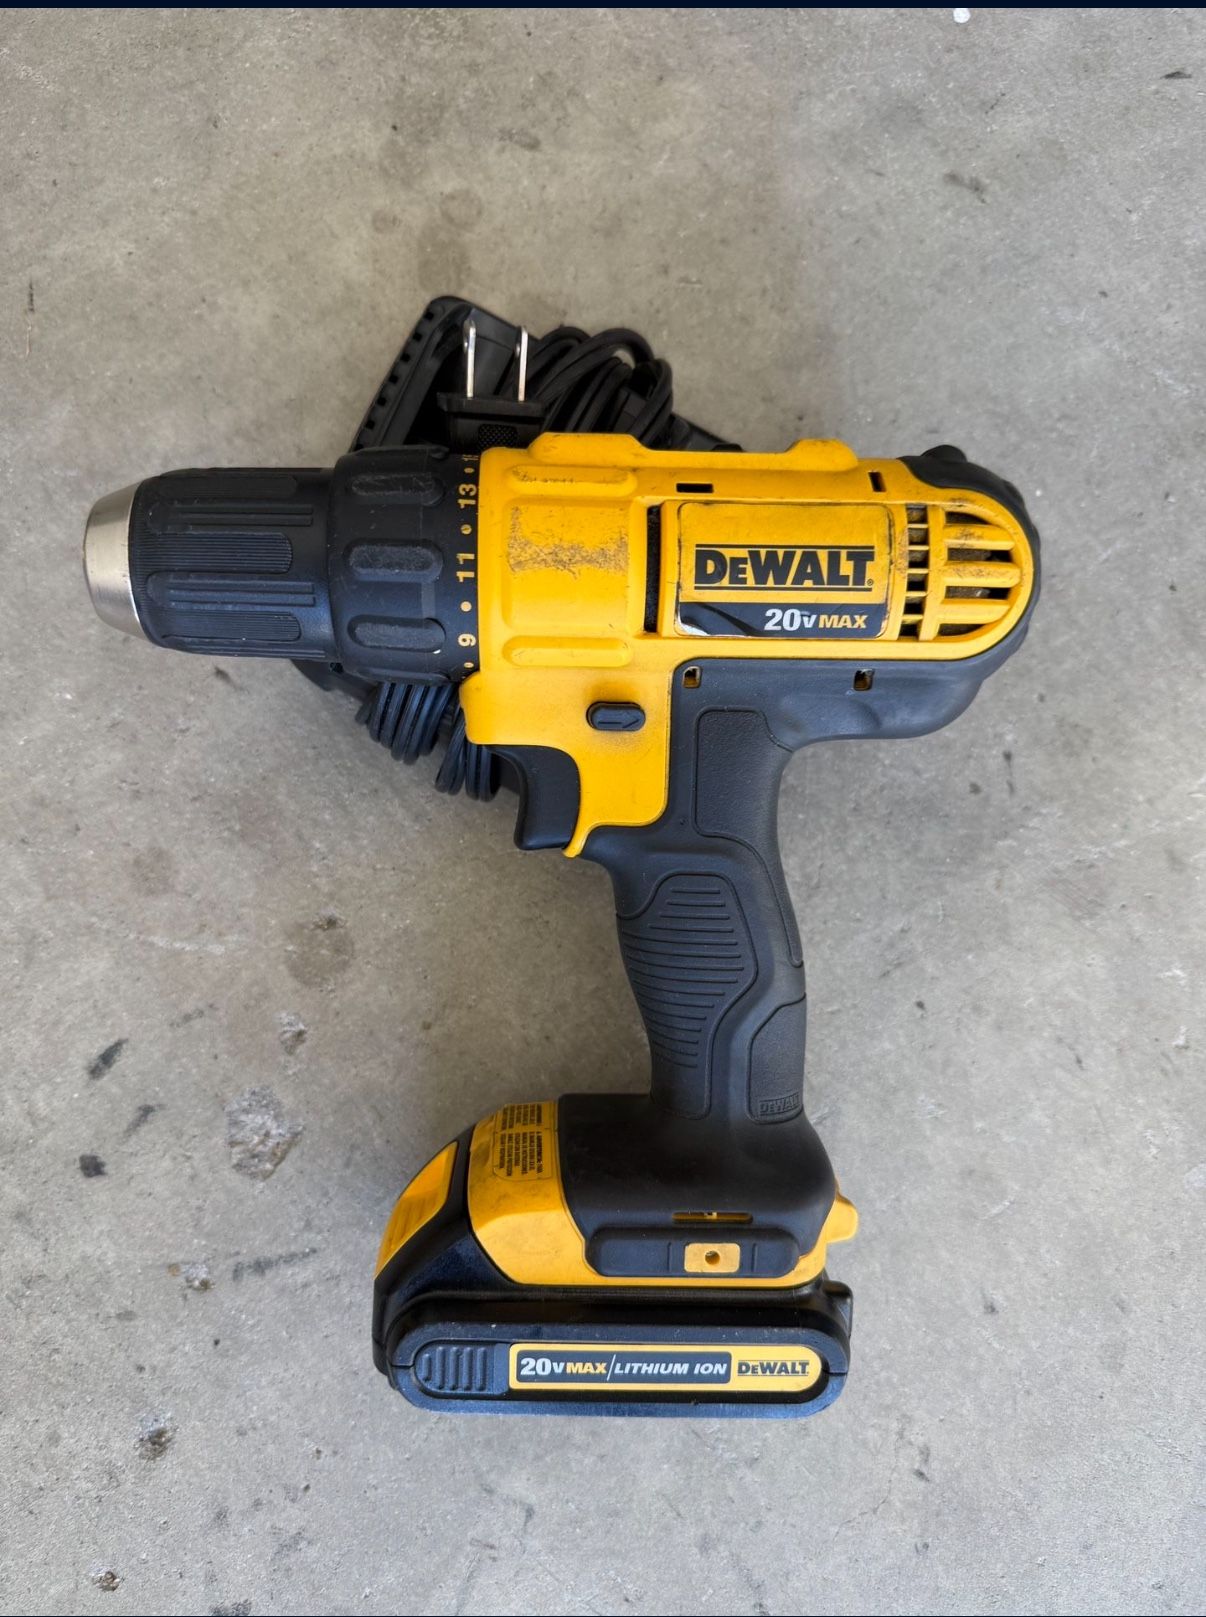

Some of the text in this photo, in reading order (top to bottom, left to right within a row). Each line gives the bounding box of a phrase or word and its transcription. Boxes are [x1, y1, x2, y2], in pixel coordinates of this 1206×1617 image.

[458, 483, 477, 509] 13
[456, 553, 475, 582] 11
[818, 614, 868, 629] MAX
[459, 633, 477, 647] 9
[614, 1362, 688, 1375] LITHIUM
[693, 1363, 728, 1375] ION
